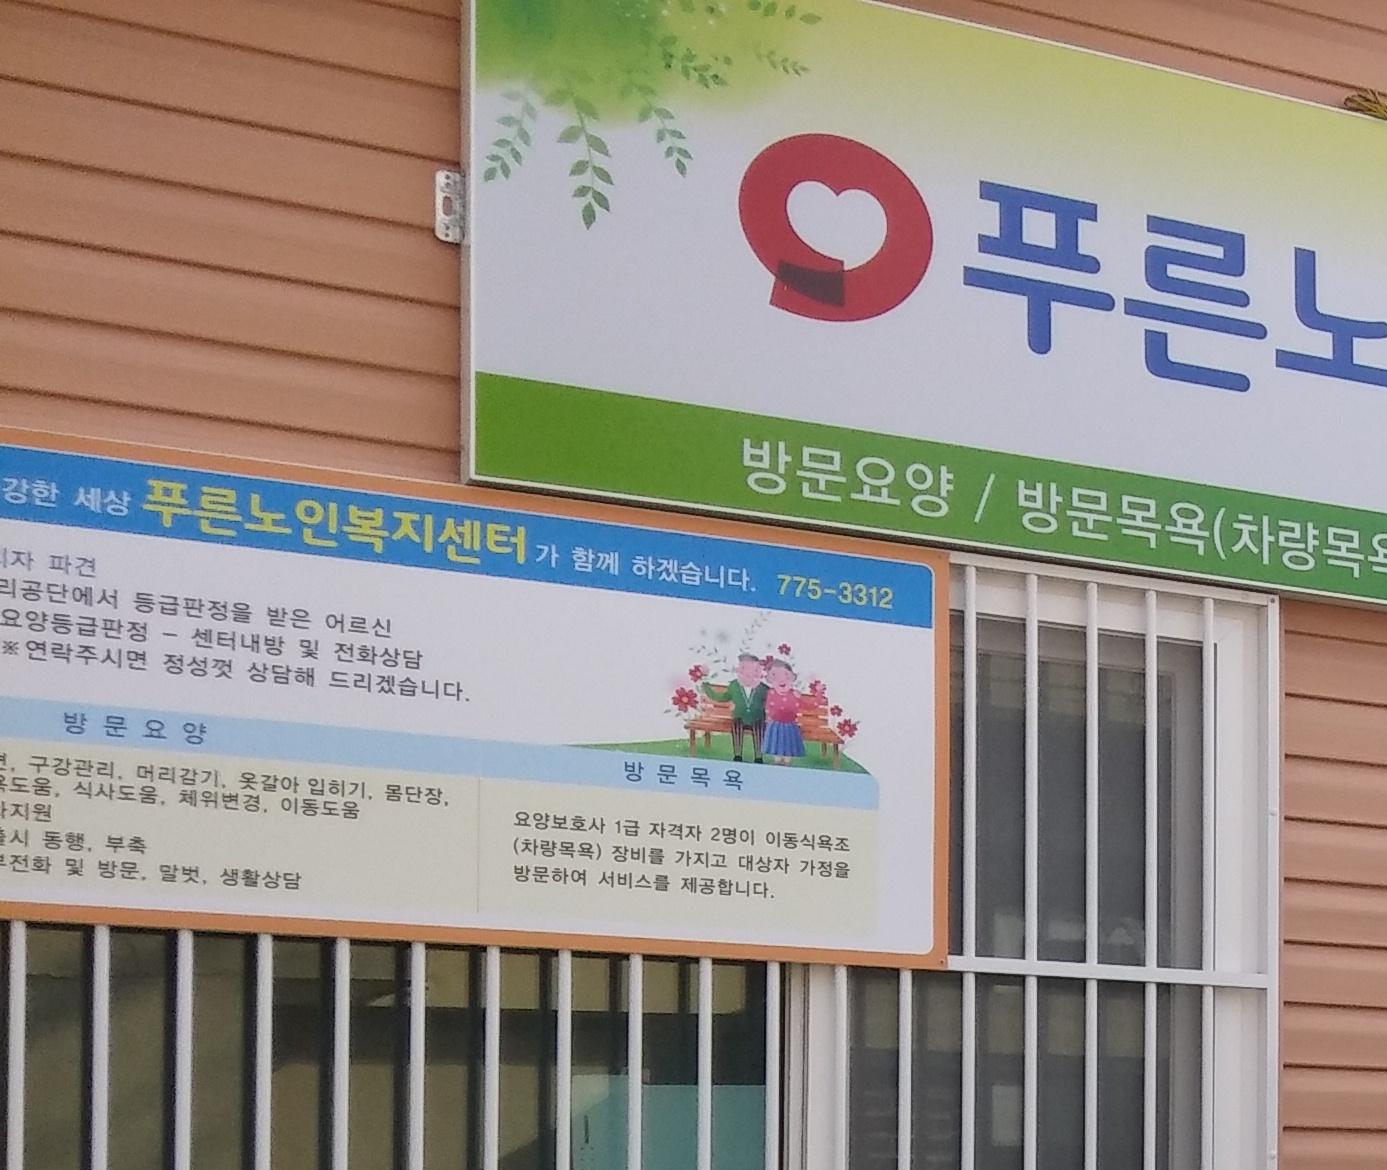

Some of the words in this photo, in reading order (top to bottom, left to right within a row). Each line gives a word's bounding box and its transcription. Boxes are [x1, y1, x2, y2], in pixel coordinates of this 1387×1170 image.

[742, 438, 955, 519] 방문요양
[0, 548, 34, 571] 자
[49, 554, 96, 578] 파견
[2, 478, 60, 508] 강한
[74, 486, 133, 516] 세상
[143, 479, 526, 564] 푸른노인복지센터
[572, 547, 619, 575] 함께
[631, 556, 756, 592] 하겠습니다.
[776, 574, 893, 609] 775-3312
[133, 592, 252, 624] 등급판정을
[267, 606, 311, 630] 받은
[326, 613, 392, 639] 어르신
[0, 608, 148, 642] 요양등급판정
[191, 628, 285, 656] 센터내방
[300, 639, 319, 660] 및
[334, 642, 423, 670] 전화상담
[163, 654, 233, 680] 정성껏
[247, 662, 315, 687] 상담해
[329, 671, 470, 702] 드리겠습니다.
[281, 797, 360, 819] 이동도움
[105, 835, 147, 854] 부축
[513, 811, 606, 834] 요양보호사
[615, 819, 640, 837] 1급
[649, 821, 702, 842] 자격자
[710, 827, 754, 846] 2명이
[766, 831, 850, 851] 이동식욕조
[66, 858, 83, 877] 및
[220, 867, 302, 890] 생활상담
[513, 837, 602, 860] (차량목욕)
[612, 846, 665, 865] 장비를
[675, 850, 727, 869] 가지고
[738, 855, 790, 874] 대상자
[800, 860, 850, 879] 가정을
[513, 865, 587, 886] 방문하여
[598, 871, 670, 891] 서비스를
[680, 877, 775, 899] 제공합니다.
